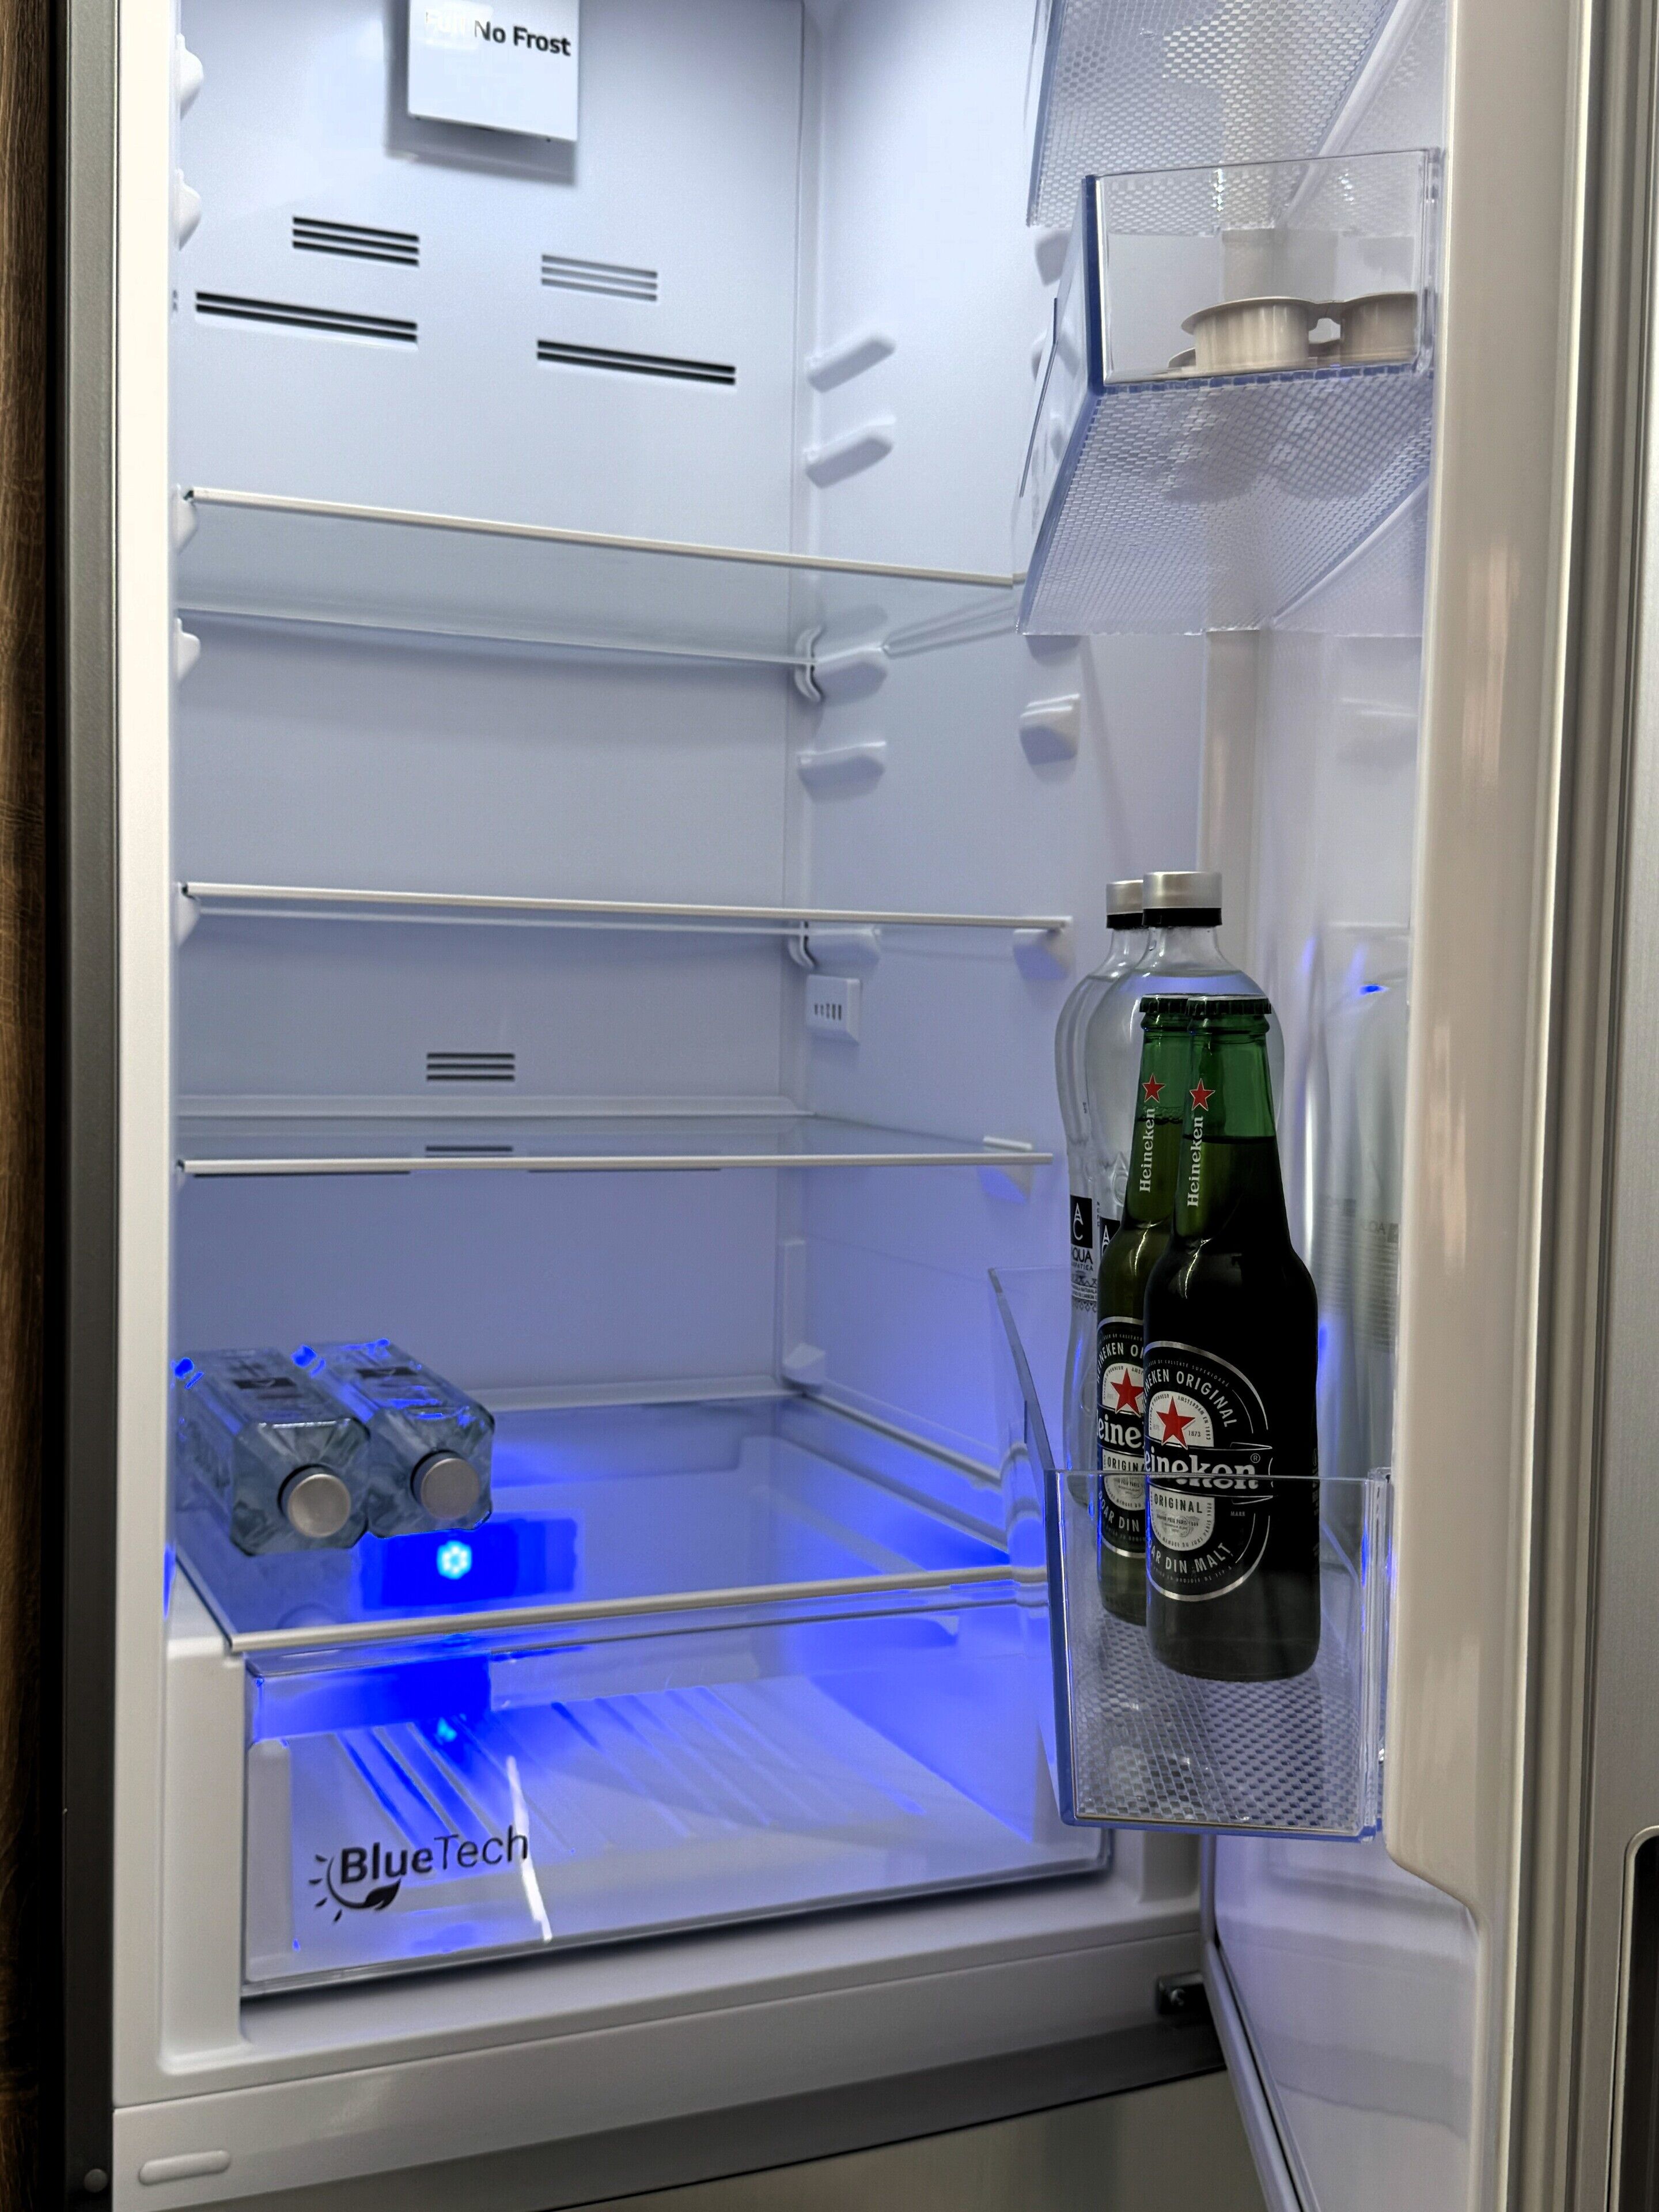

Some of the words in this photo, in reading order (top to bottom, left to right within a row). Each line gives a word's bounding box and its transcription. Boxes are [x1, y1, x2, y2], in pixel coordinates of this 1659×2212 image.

[474, 21, 506, 43] No
[513, 26, 571, 56] Frost
[1139, 1108, 1155, 1193] Heineken
[1187, 1115, 1203, 1207] Heineken
[1071, 1247, 1093, 1265] QUA
[1176, 1370, 1237, 1428] ORIGINAL
[1098, 1414, 1143, 1448] eine
[1145, 1446, 1259, 1490] eineken
[1154, 1494, 1203, 1513] ORIGINAL
[1119, 1516, 1140, 1532] DIN
[1165, 1556, 1187, 1574] DIN
[341, 1825, 528, 1884] BlueTech
